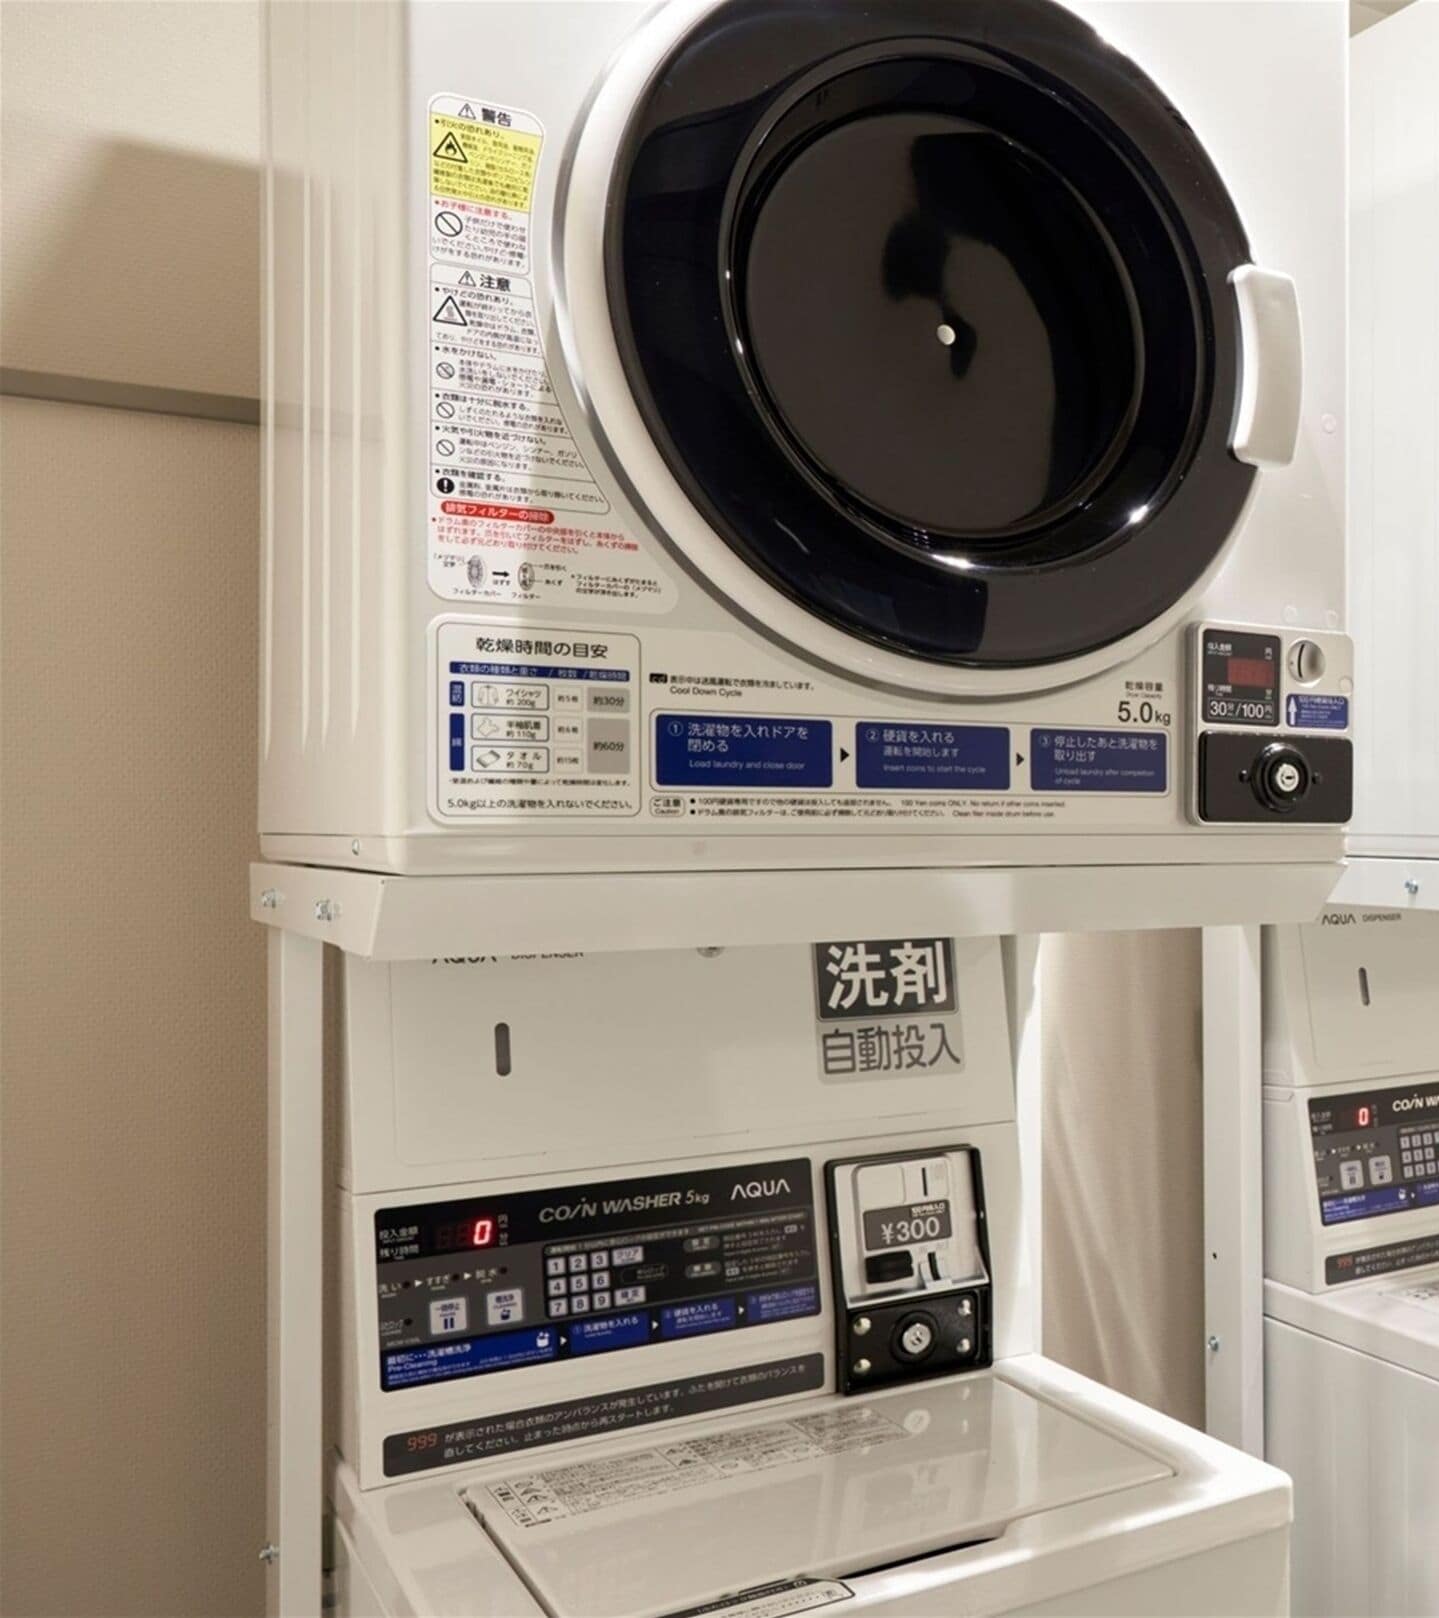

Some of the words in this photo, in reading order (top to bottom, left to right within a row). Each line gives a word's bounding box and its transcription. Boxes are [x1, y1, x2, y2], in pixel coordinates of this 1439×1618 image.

[481, 107, 512, 127] 警告
[480, 273, 511, 292] 注意
[476, 637, 609, 660] 乾燥時間の目安
[670, 685, 690, 695] Cool
[692, 686, 717, 696] Down
[687, 721, 809, 740] 洗濯物を入れドアを
[883, 728, 955, 744] 硬貨を入れる
[687, 738, 729, 753] 閉める
[1054, 735, 1158, 750] 停止したあと洗濯物を
[688, 759, 711, 769] Load
[713, 759, 744, 770] laundry
[1054, 749, 1096, 762] 取り出す
[1321, 913, 1357, 926] AQUA
[825, 940, 948, 1010] 洗剤
[822, 1022, 961, 1075] 自動投入
[1358, 1106, 1369, 1126] 0
[539, 1197, 598, 1223] COIN
[602, 1191, 682, 1212] WASHER
[686, 1189, 710, 1205] 5kg
[731, 1178, 791, 1201] AQUA
[473, 1219, 493, 1245] 0
[881, 1216, 941, 1245] ¥300
[552, 1262, 560, 1273] 1
[574, 1258, 583, 1269] 2
[595, 1254, 604, 1266] 3
[553, 1282, 562, 1293] 4
[575, 1278, 583, 1289] 5
[596, 1275, 605, 1287] 6
[554, 1302, 562, 1313] 7
[576, 1298, 584, 1309] 8
[598, 1295, 606, 1306] 9
[406, 1431, 439, 1453] 999
